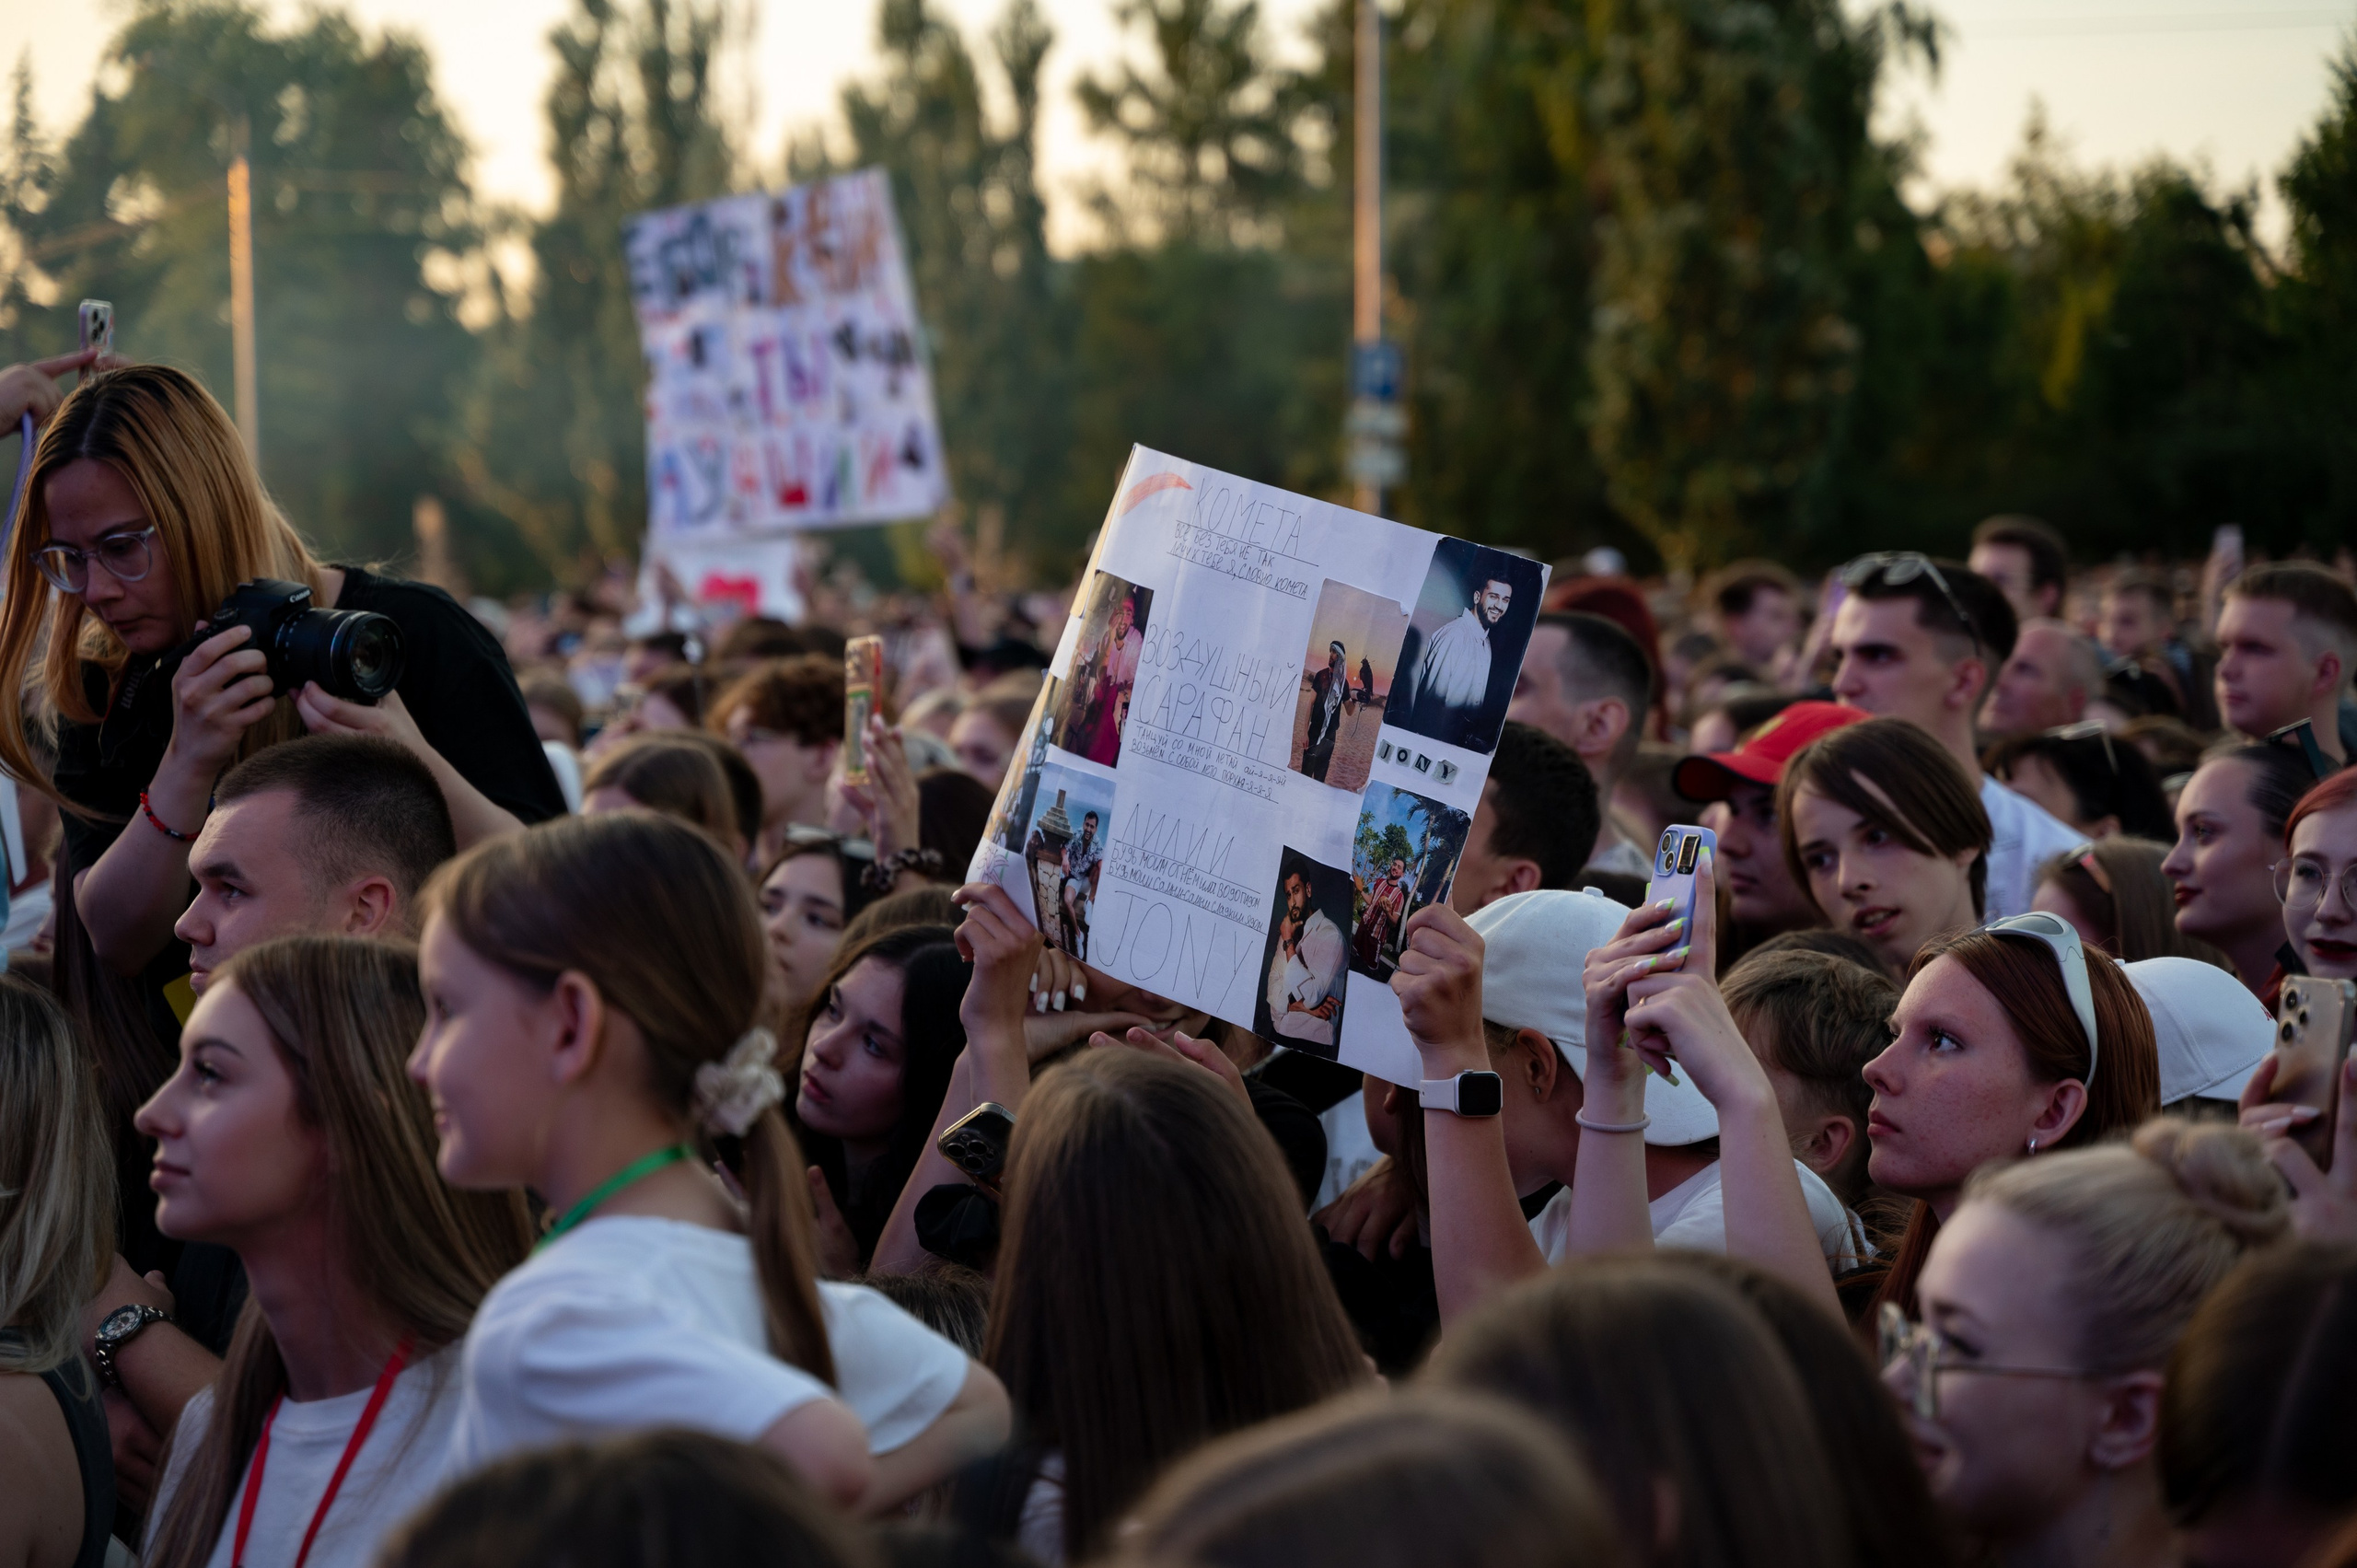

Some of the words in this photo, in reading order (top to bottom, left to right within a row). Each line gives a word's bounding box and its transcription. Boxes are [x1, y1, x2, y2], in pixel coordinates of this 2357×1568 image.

[1192, 478, 1302, 557] КОМЕТА
[289, 589, 311, 603] Canon
[1259, 549, 1275, 567] ТАК
[1142, 623, 1298, 714] ВОЗДУШНЫЙ
[1139, 675, 1271, 761] САРАФАН
[1380, 743, 1456, 780] JONY
[1120, 804, 1235, 878] ЛИЛИИ
[1096, 890, 1254, 1013] JONY
